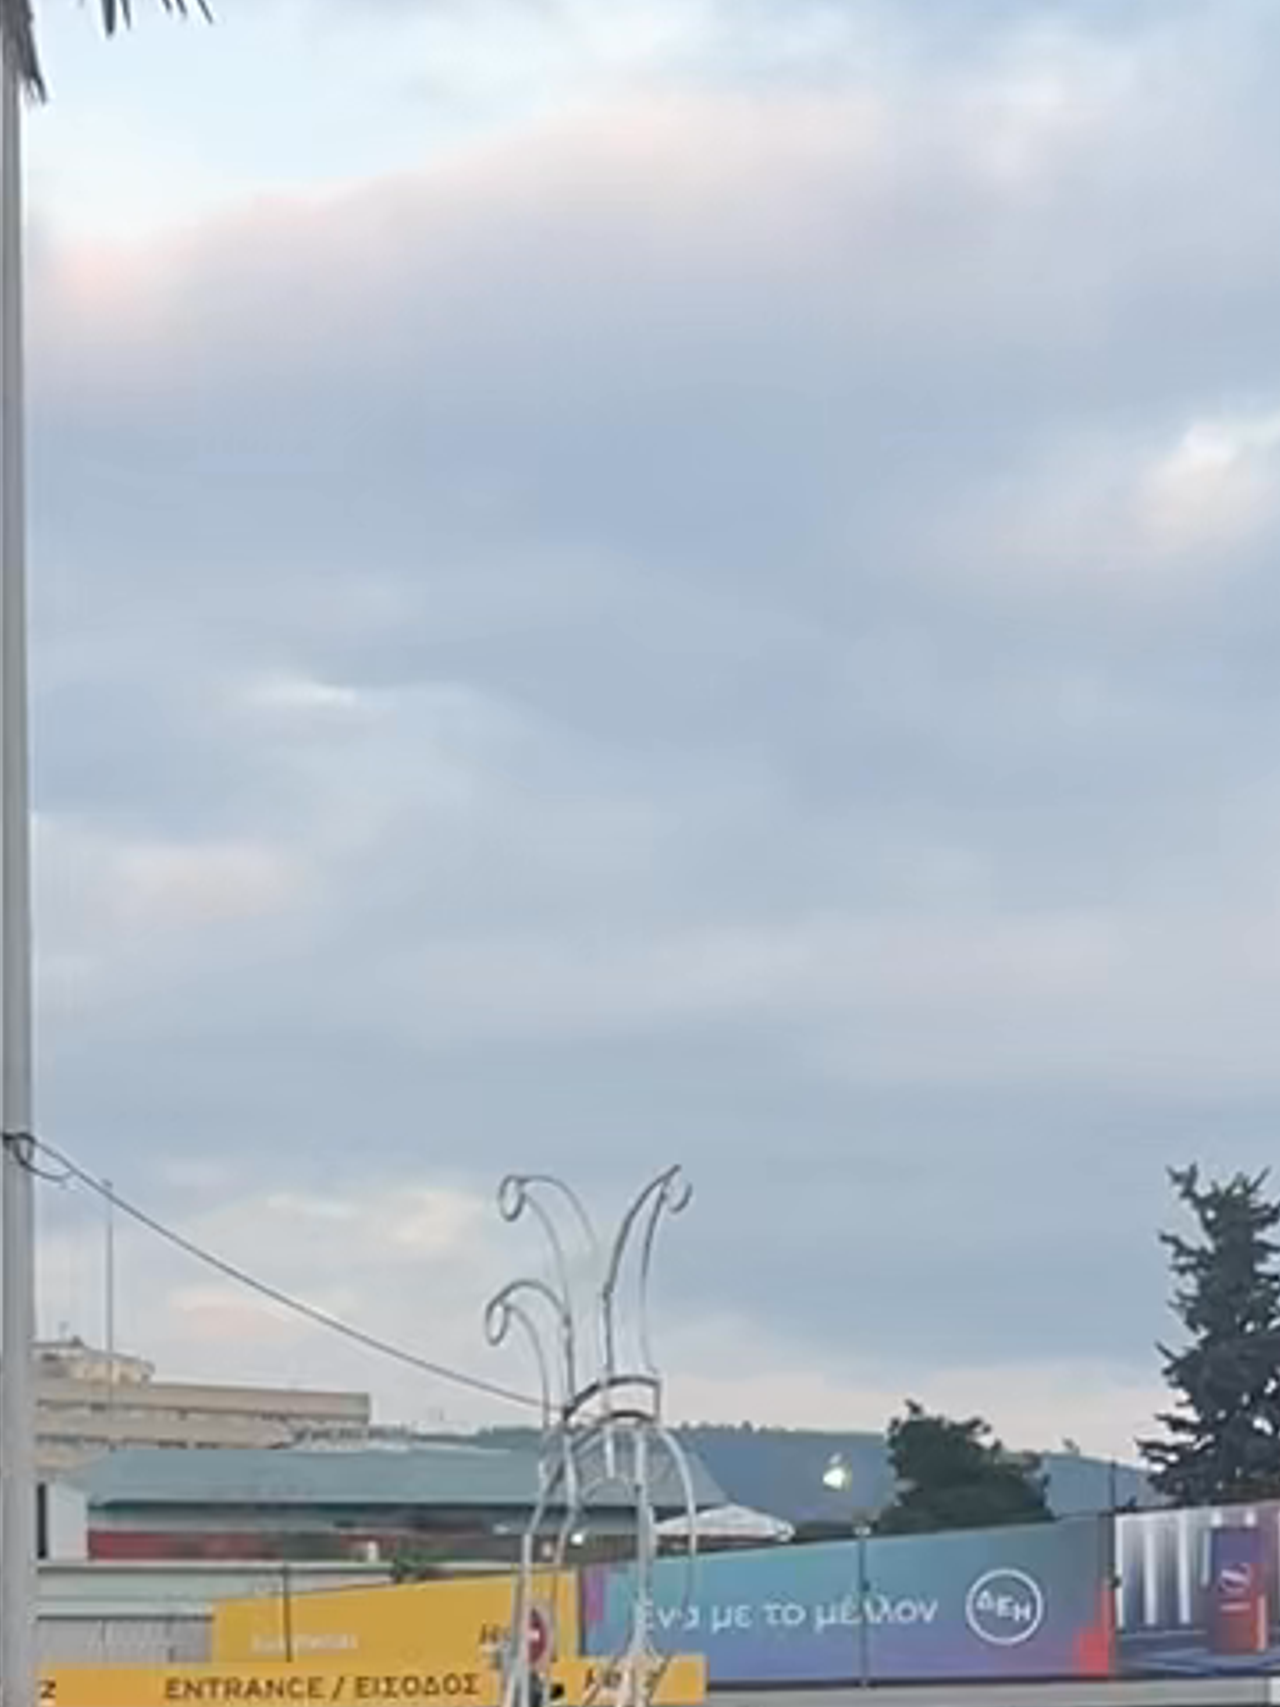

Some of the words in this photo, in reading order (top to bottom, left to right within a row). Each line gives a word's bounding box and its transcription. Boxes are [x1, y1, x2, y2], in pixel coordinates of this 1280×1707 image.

[711, 1603, 751, 1635] με
[764, 1598, 807, 1625] το
[164, 1675, 323, 1701] ENTRANCE
[355, 1672, 481, 1699] ΕΙΣΟΔΟΣ
